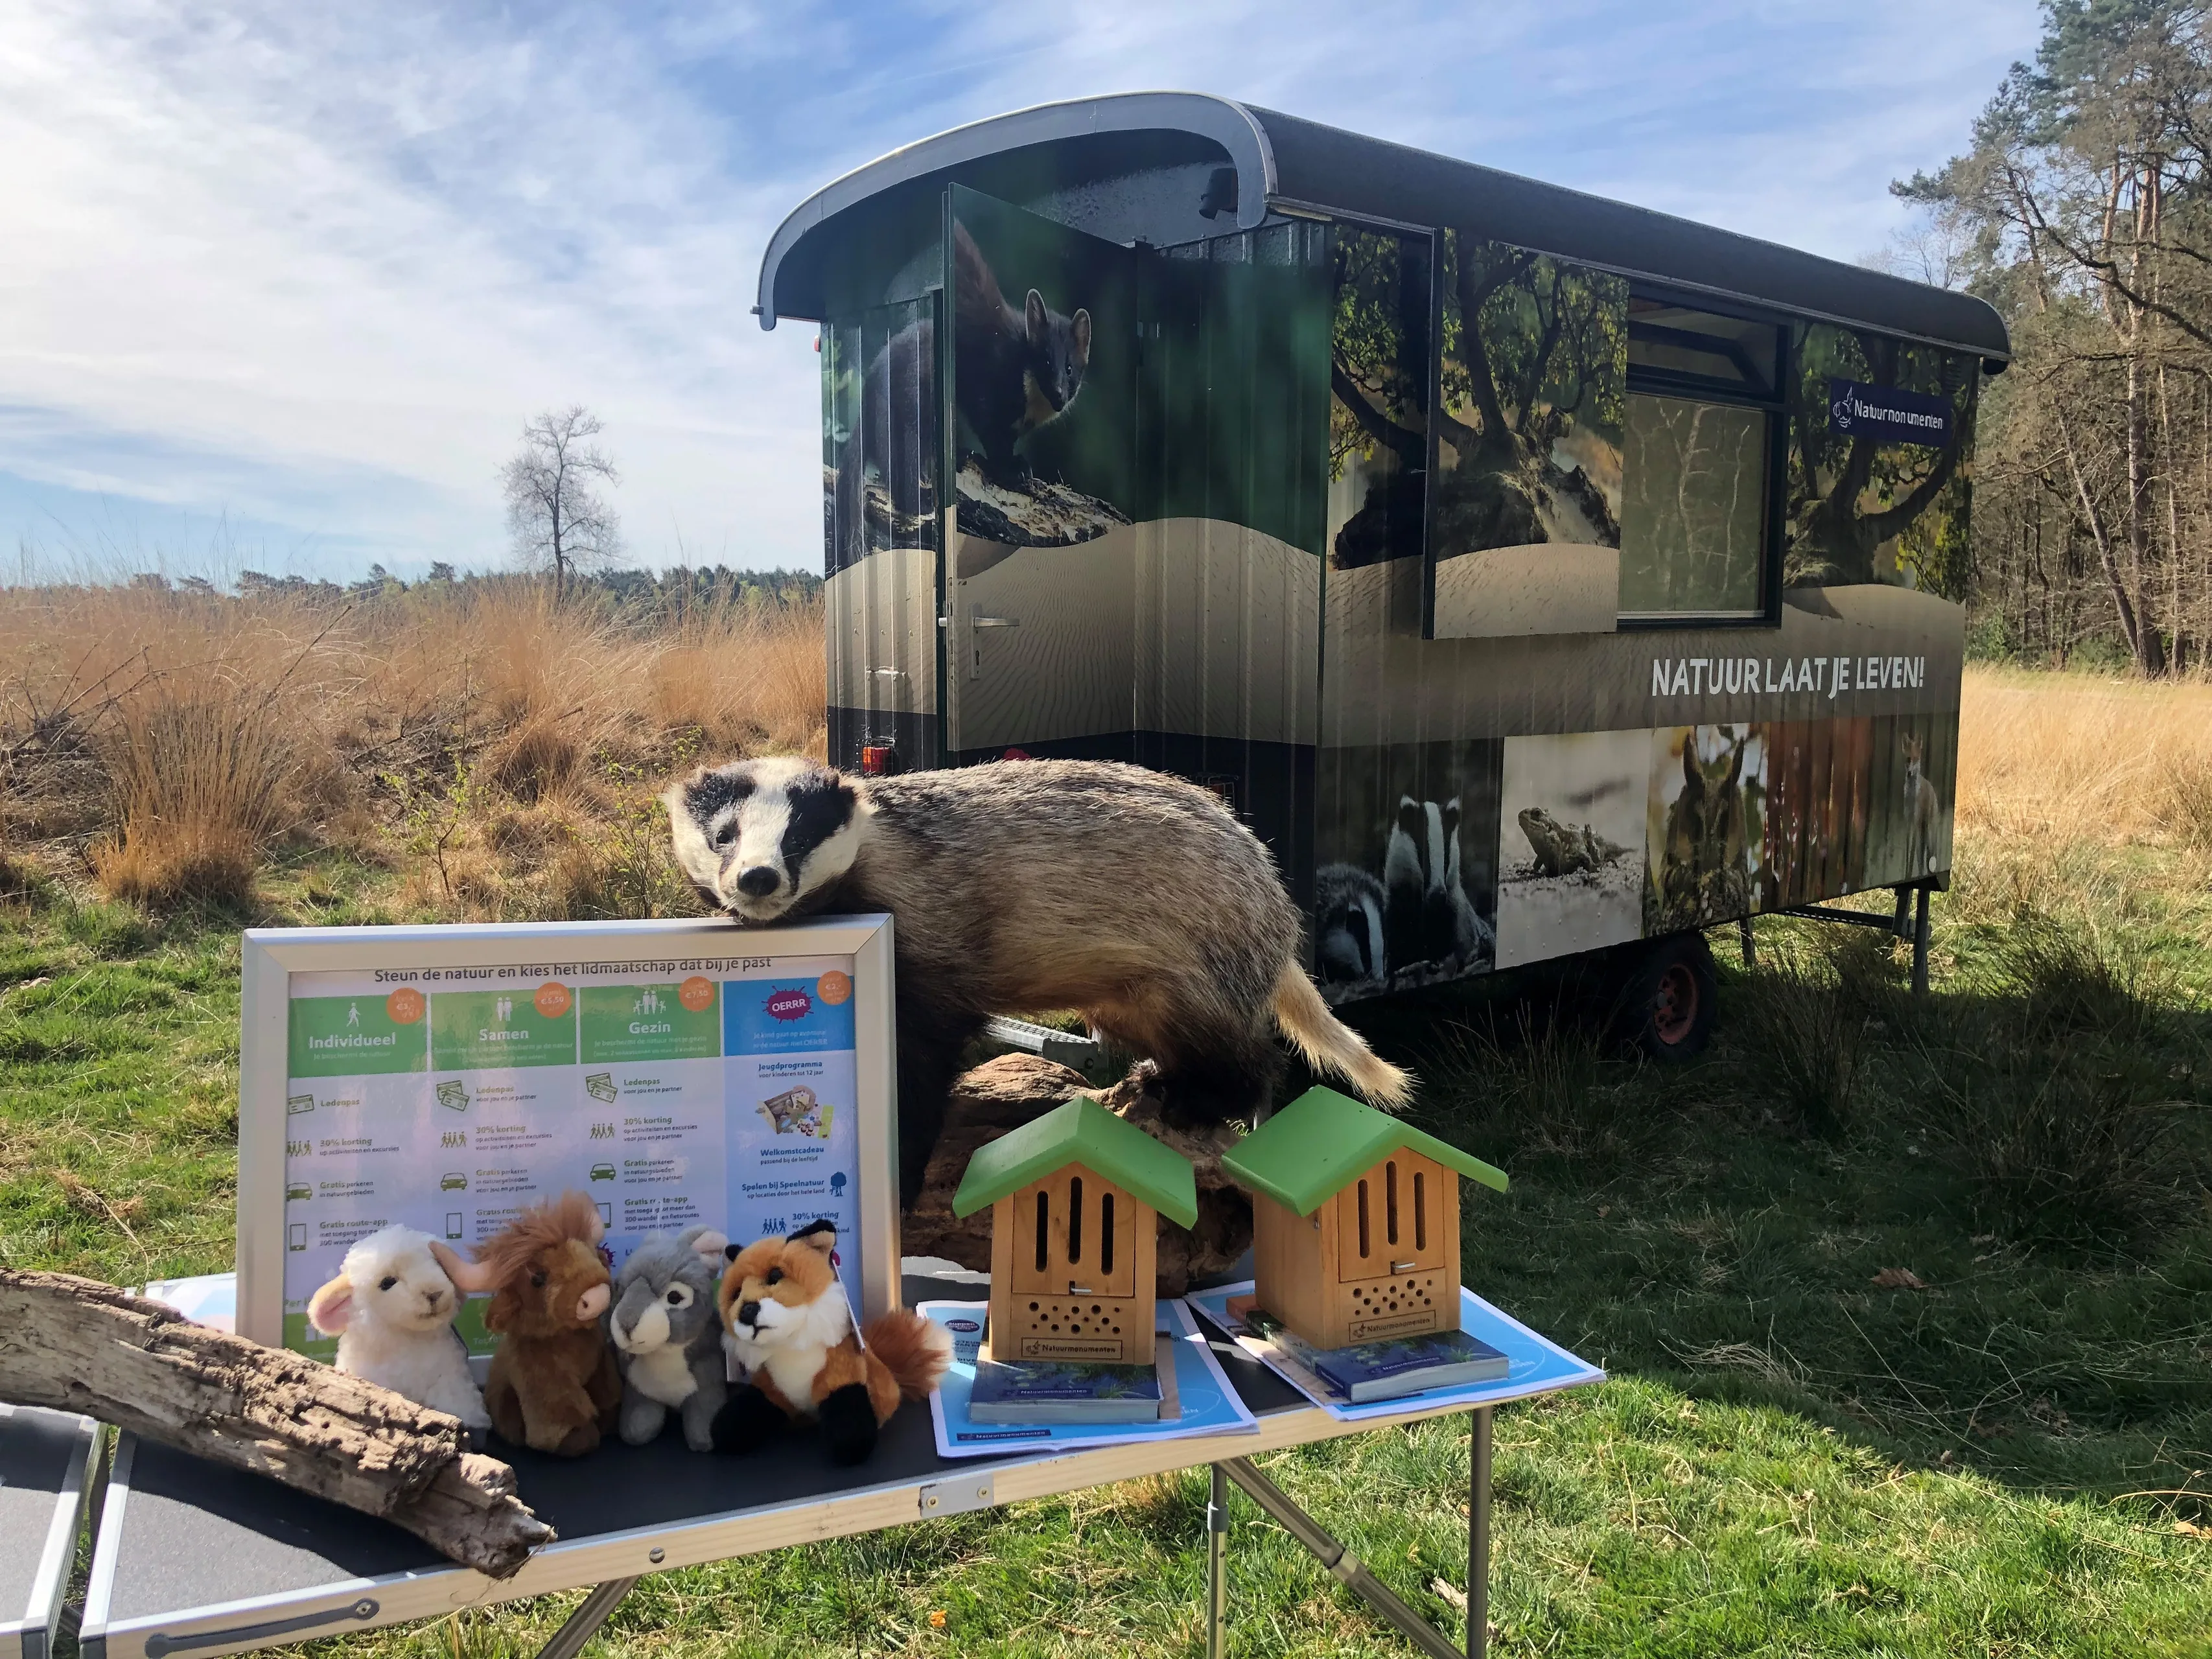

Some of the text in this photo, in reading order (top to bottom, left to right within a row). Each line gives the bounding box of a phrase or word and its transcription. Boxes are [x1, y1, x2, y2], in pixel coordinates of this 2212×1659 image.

[1652, 656, 1924, 699] NATUUR LAAT JE LEVEN!
[375, 958, 771, 982] Steun de natuur en kies het lidmaatschap dat bij je past
[772, 999, 806, 1012] OERRR
[629, 1021, 671, 1034] Gezin
[480, 1028, 529, 1041] Samen
[309, 1032, 395, 1049] Individueel
[759, 1061, 822, 1071] Jeugdprogramma
[624, 1078, 660, 1087] Ledenpas
[321, 1098, 360, 1108] Ledenpas
[496, 1125, 526, 1133] korting
[320, 1137, 372, 1147] 30% korting
[761, 1146, 824, 1157] Welkomstcadeau
[320, 1181, 345, 1189] Gratis
[742, 1180, 824, 1192] Spelen bij Speelnatuur
[811, 1211, 839, 1220] korting
[320, 1219, 388, 1229] Gratis route-app
[1367, 1317, 1430, 1333] Natuurmonumenten
[1042, 1343, 1116, 1354] Natuurmonumenten
